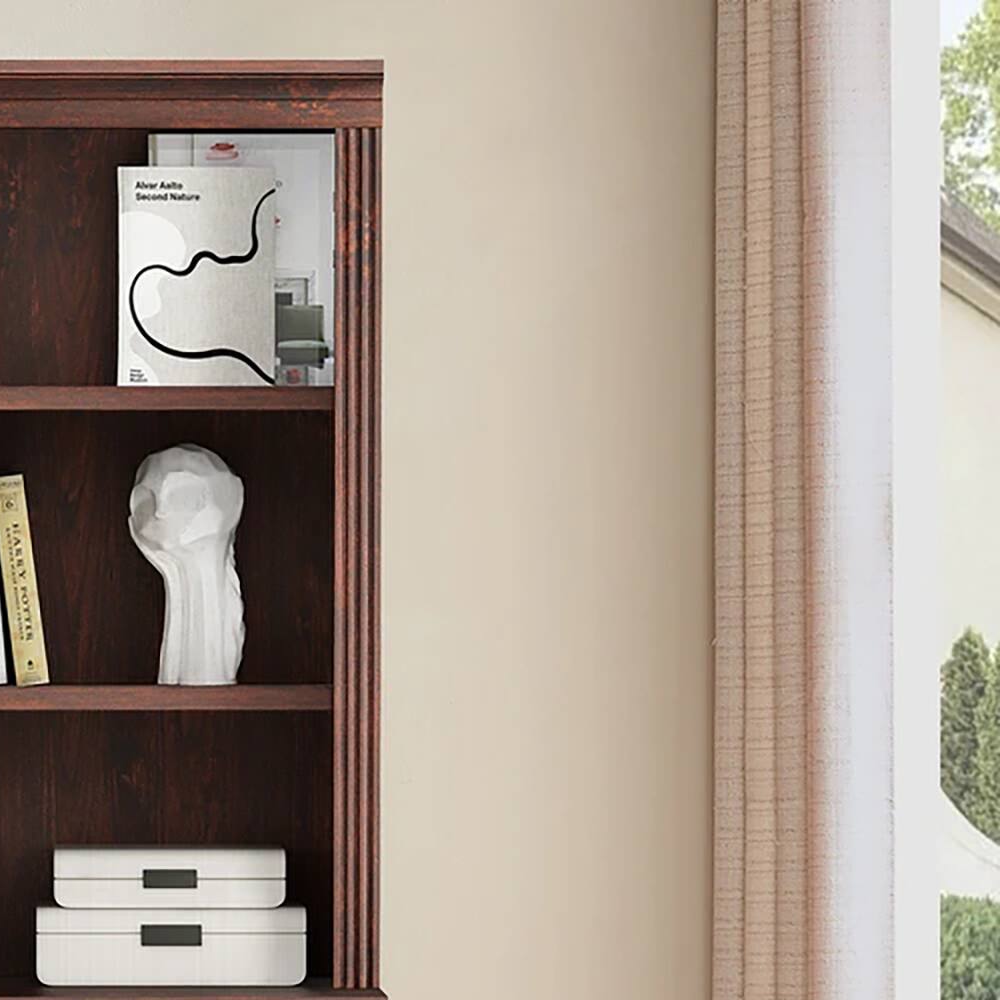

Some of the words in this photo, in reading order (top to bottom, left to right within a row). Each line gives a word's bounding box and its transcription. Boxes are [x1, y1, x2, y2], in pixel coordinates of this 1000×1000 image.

[135, 181, 159, 190] Alvar
[160, 181, 183, 190] Aalto
[135, 193, 168, 201] Second
[169, 193, 201, 201] Nature
[11, 523, 26, 580] HARRY
[20, 585, 33, 641] POTTER
